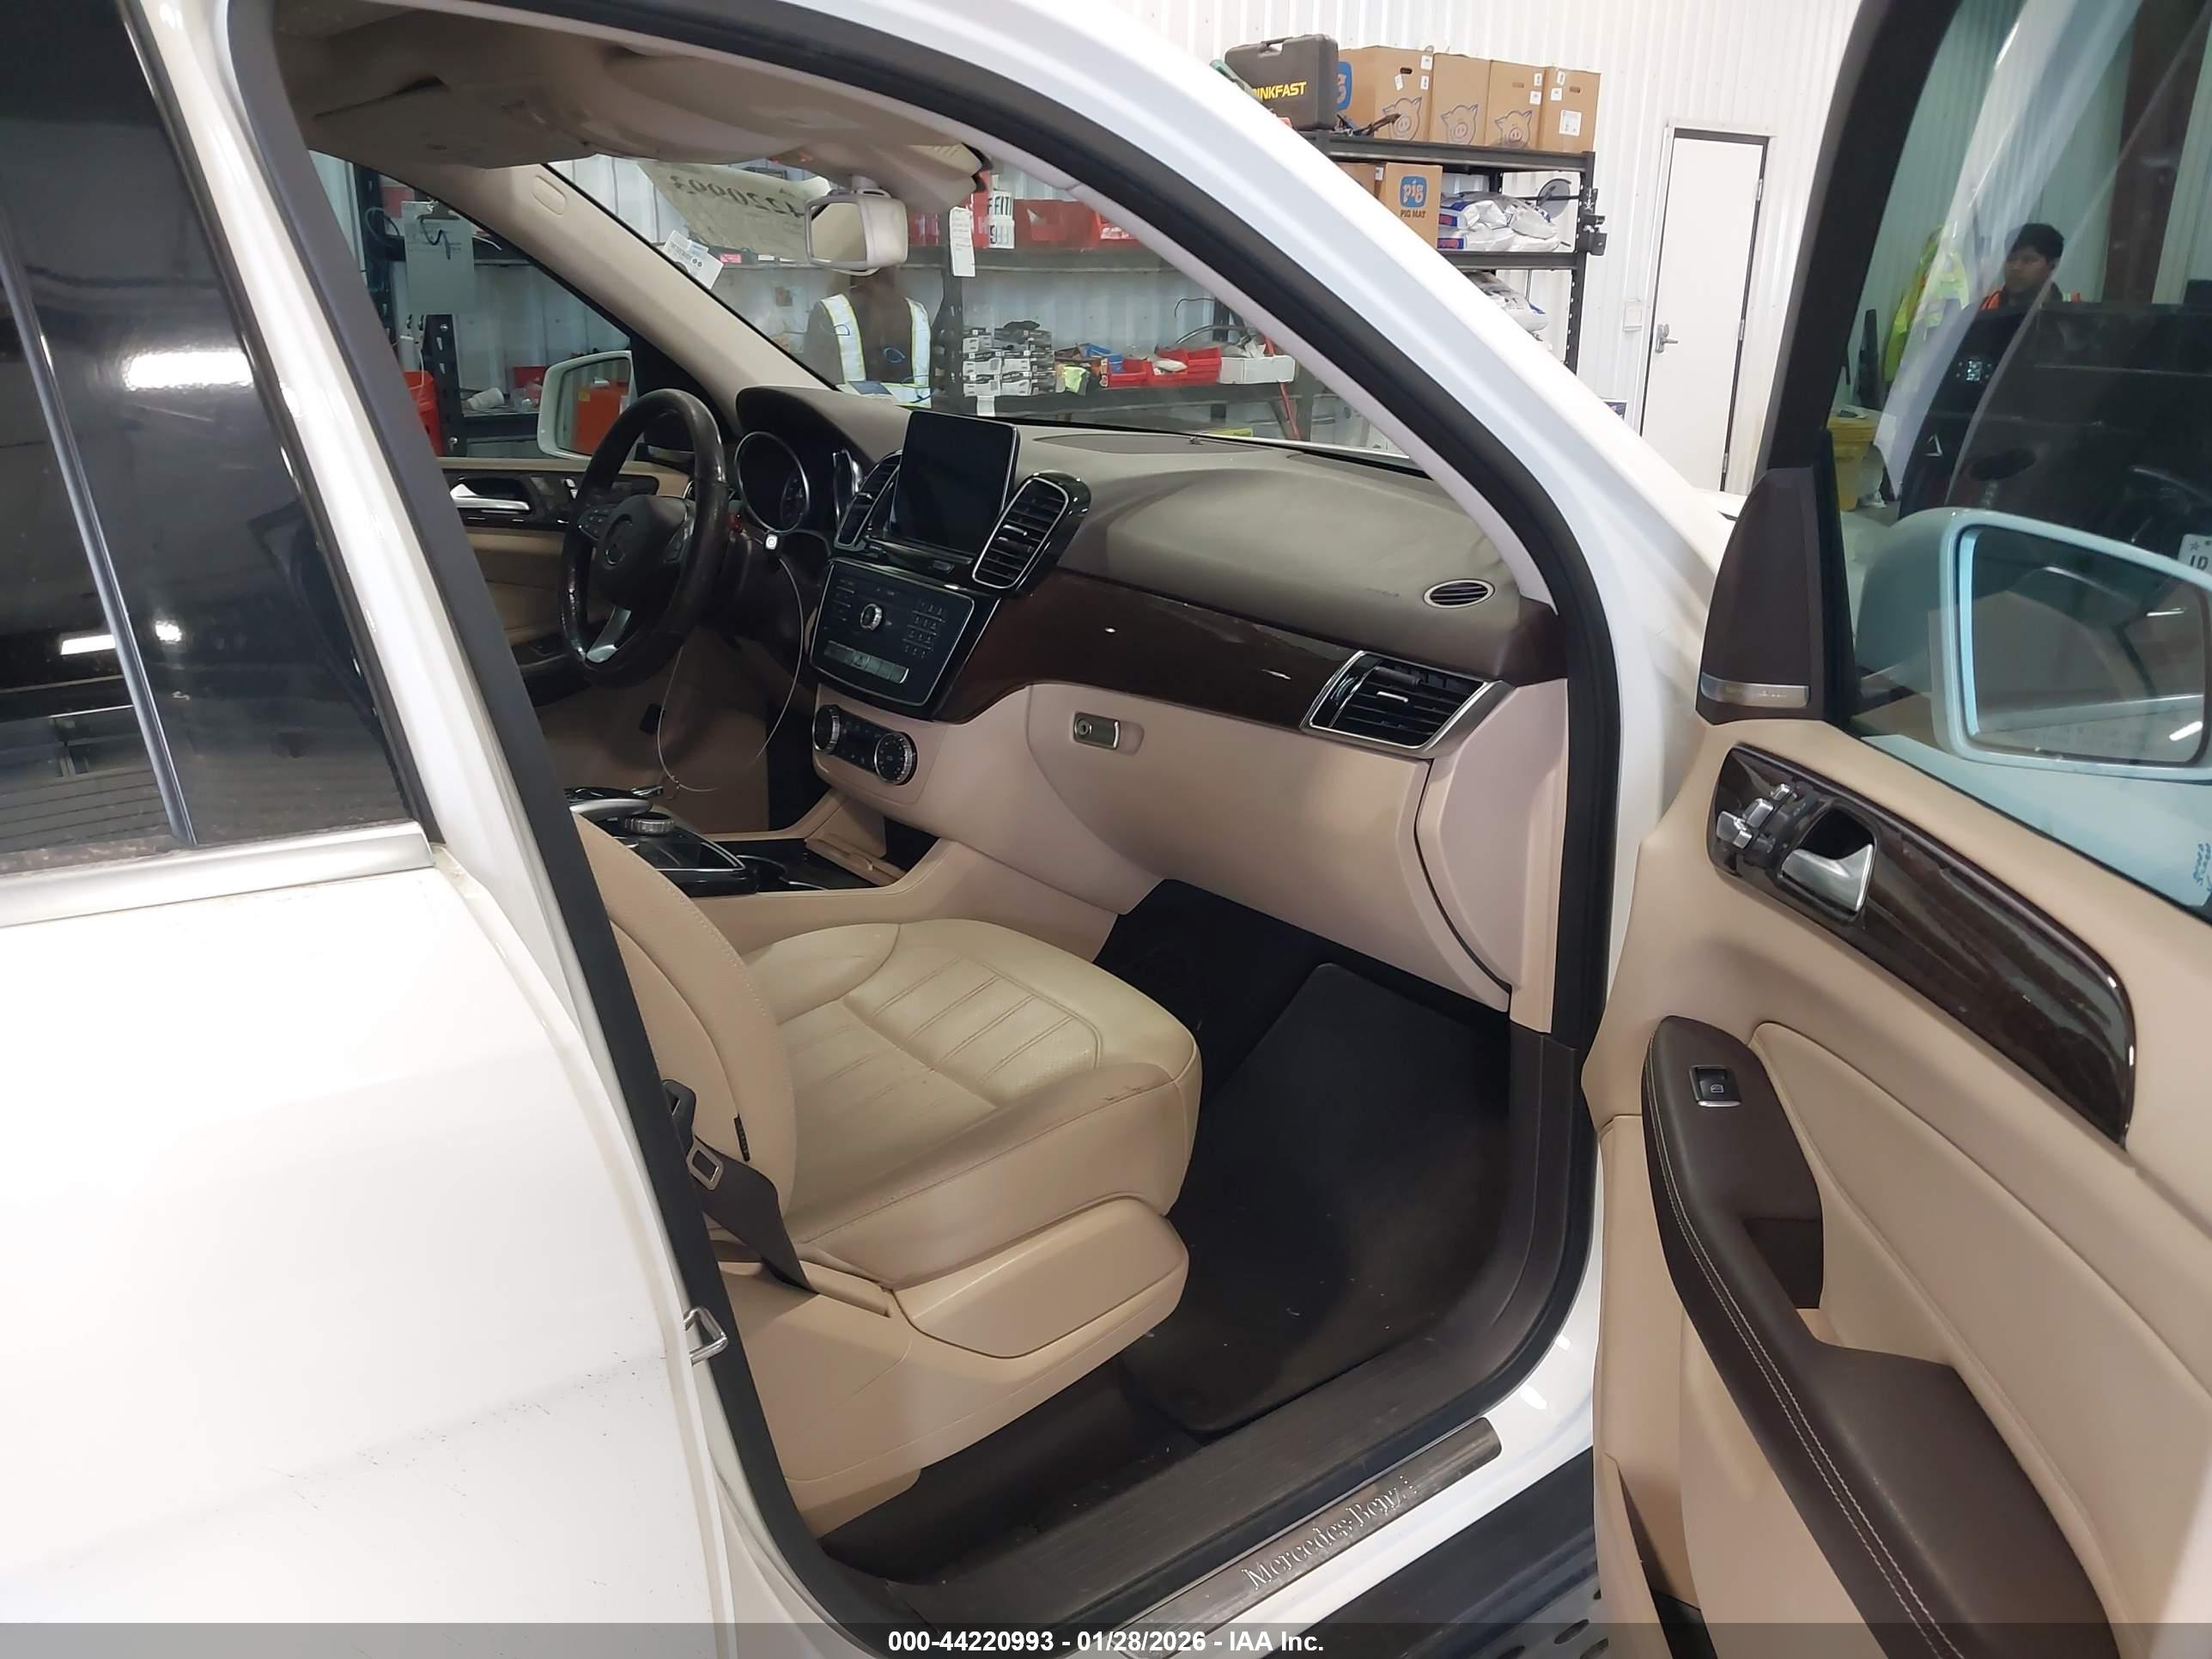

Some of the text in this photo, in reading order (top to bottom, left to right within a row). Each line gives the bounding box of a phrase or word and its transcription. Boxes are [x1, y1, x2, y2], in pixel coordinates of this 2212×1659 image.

[1402, 179, 1424, 204] pig
[1400, 209, 1426, 218] PIG MAT
[1241, 1481, 1408, 1591] Mercedes-Benz
